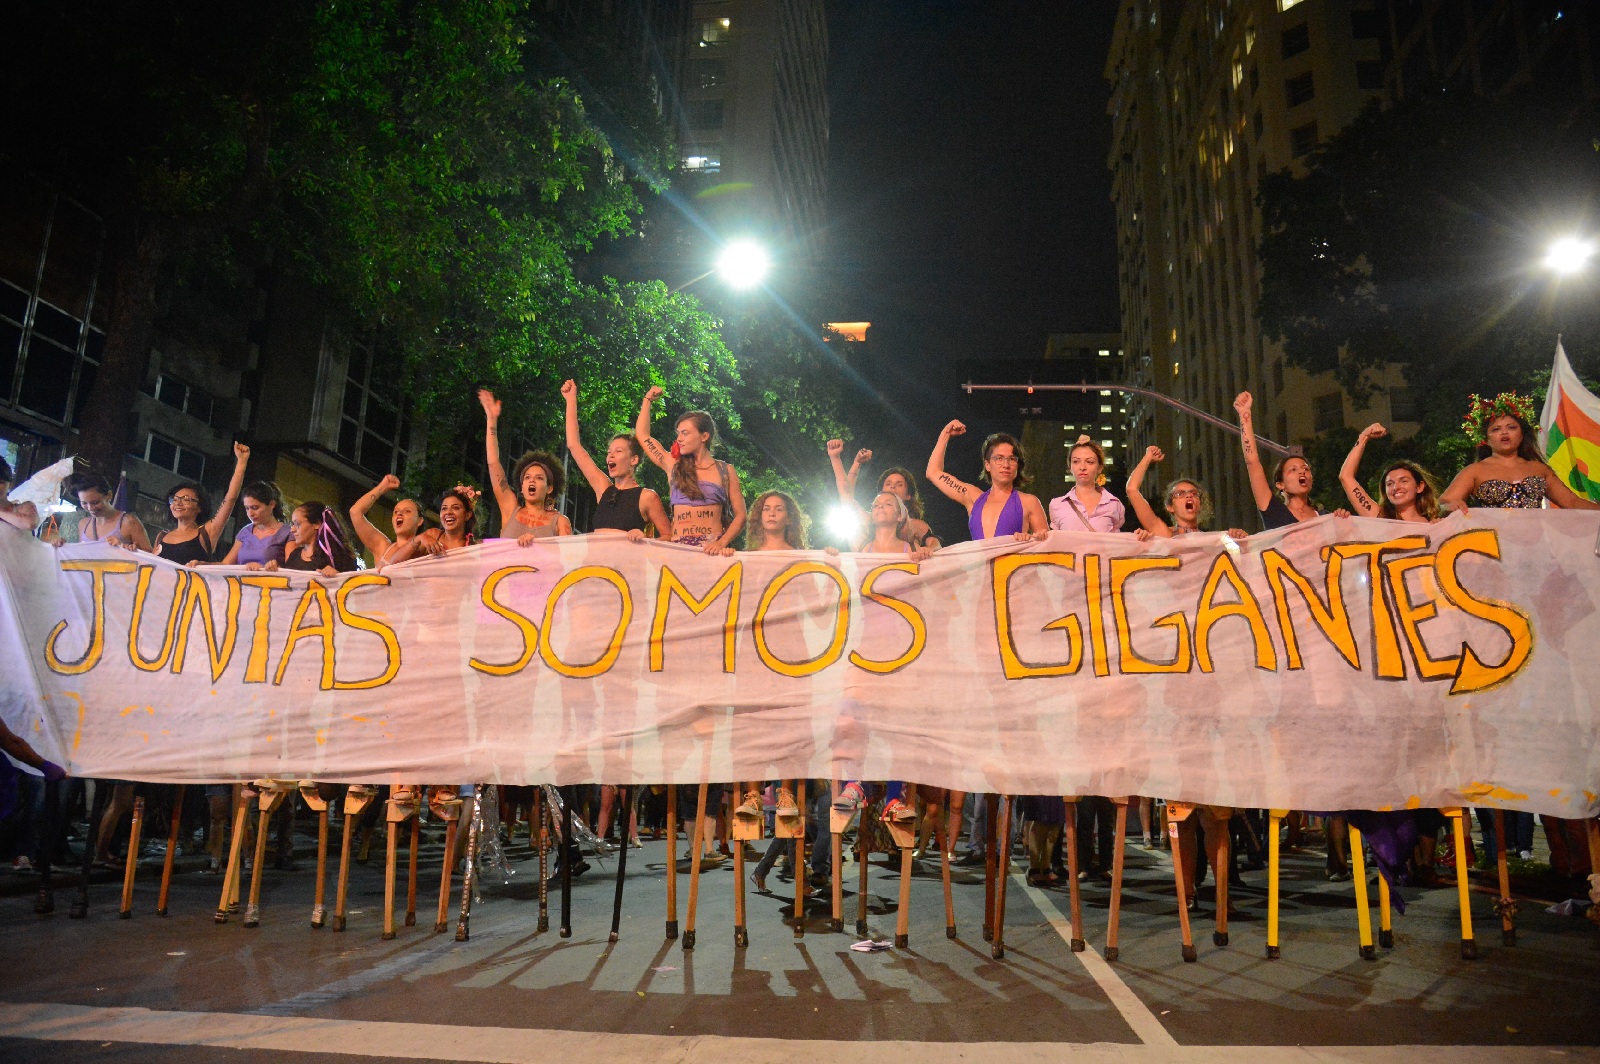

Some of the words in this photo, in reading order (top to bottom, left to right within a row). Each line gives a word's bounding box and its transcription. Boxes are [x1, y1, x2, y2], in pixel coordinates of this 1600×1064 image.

[939, 474, 968, 495] MULHER
[678, 511, 692, 520] NEM
[697, 510, 714, 518] UMA
[44, 559, 402, 691] JUNTAS
[469, 560, 928, 679] SOMOS
[990, 528, 1535, 696] GIGANTES
